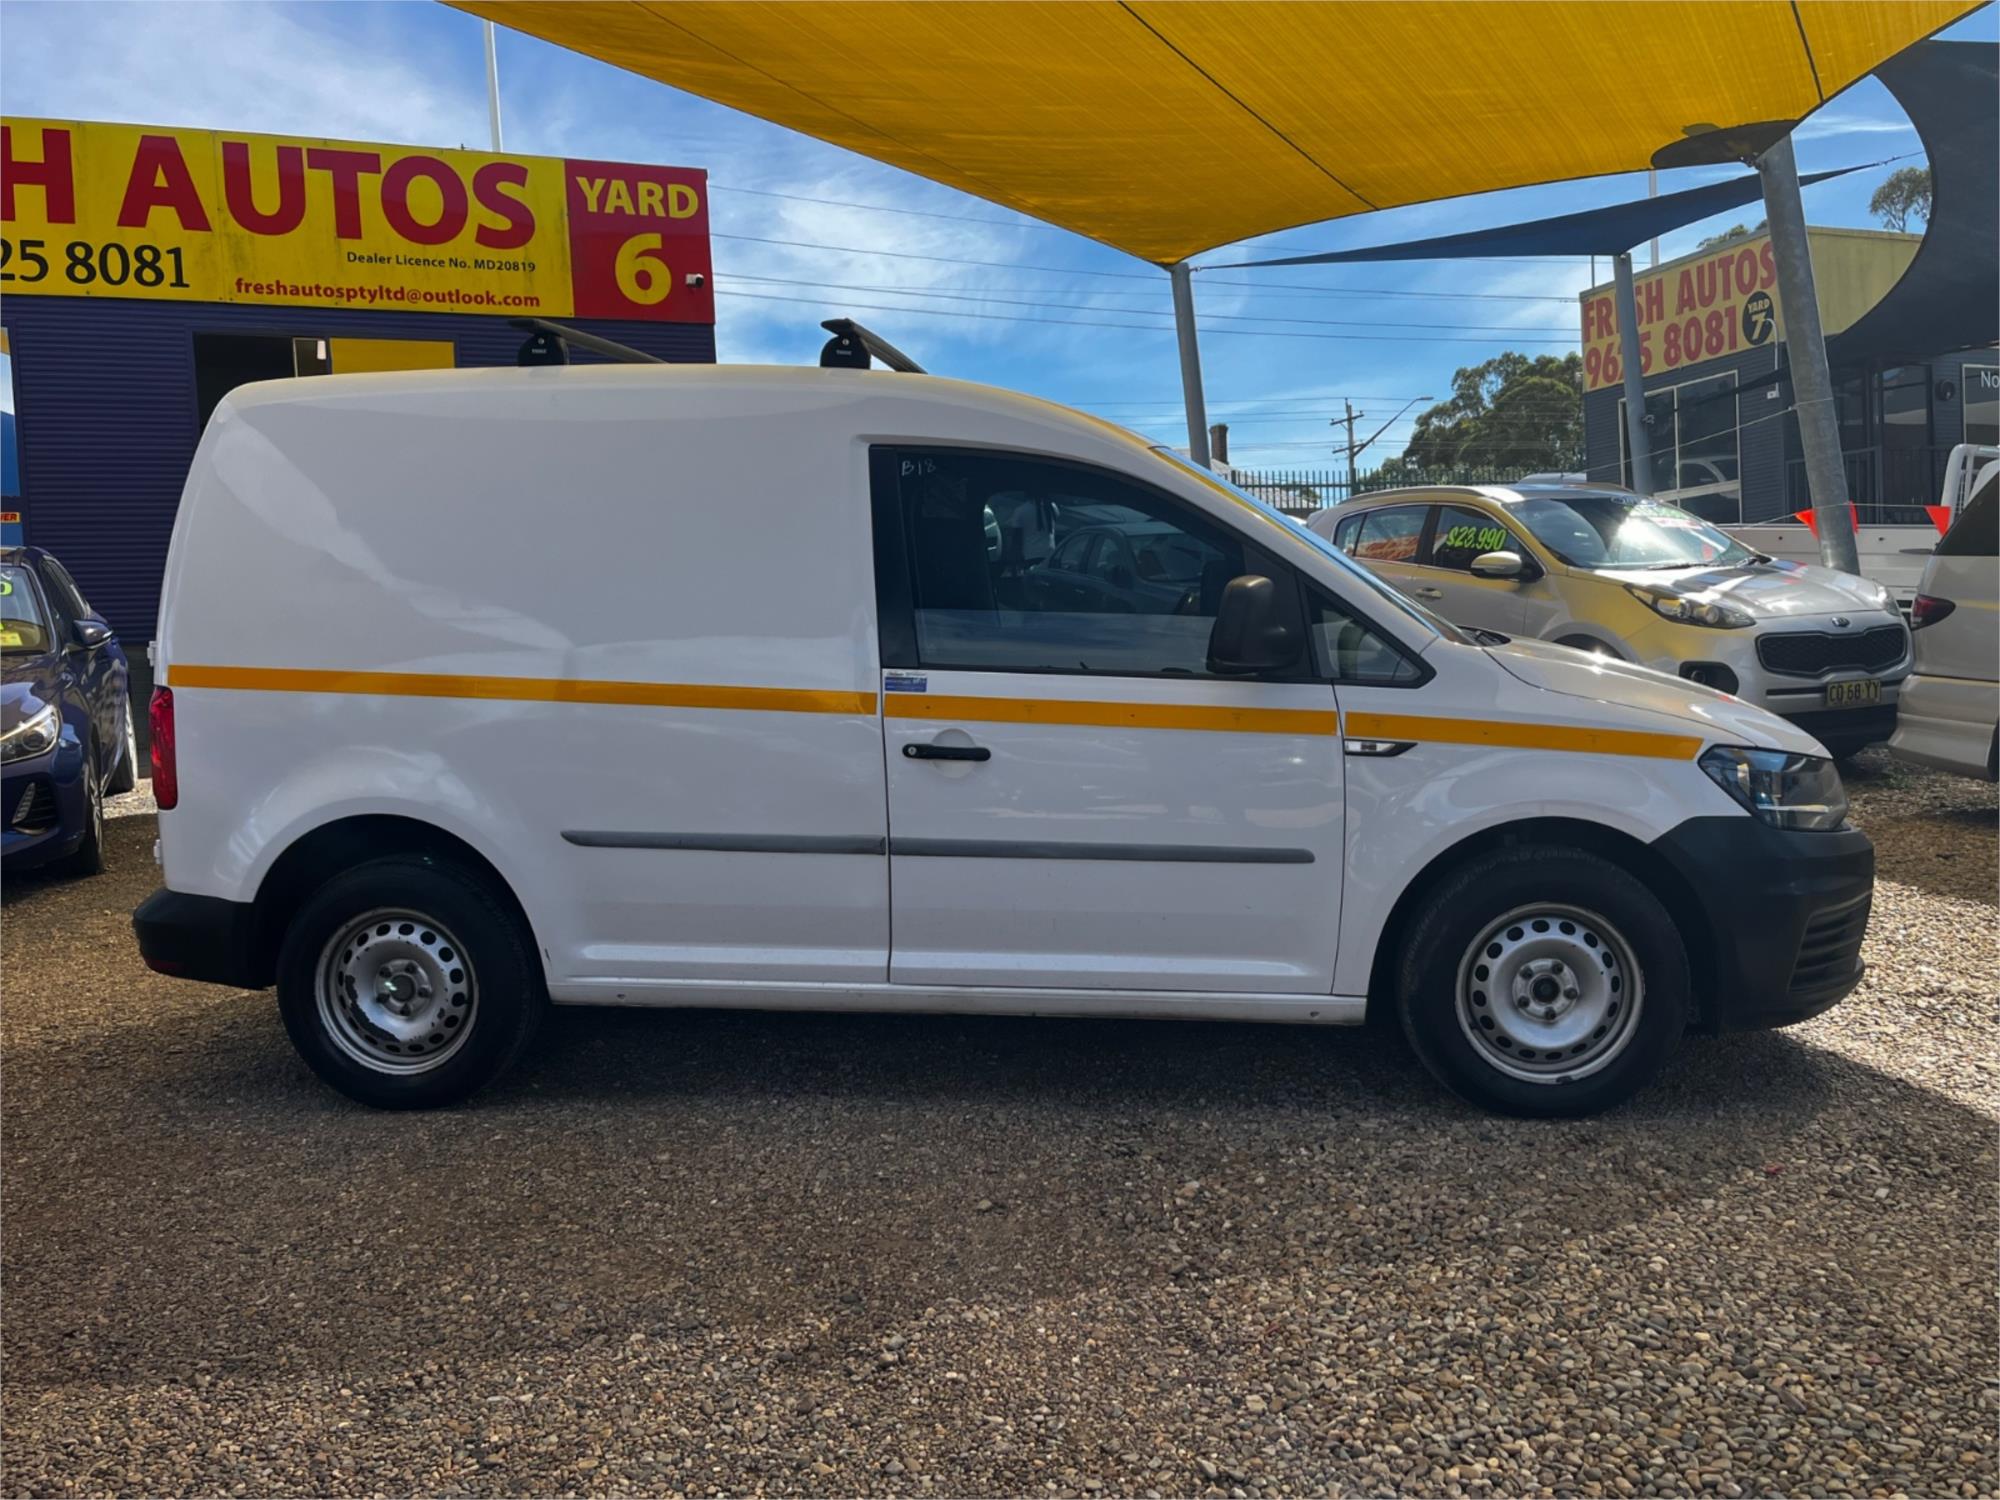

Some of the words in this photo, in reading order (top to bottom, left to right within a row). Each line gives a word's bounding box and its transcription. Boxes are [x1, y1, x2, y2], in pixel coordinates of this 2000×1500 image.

[117, 134, 536, 250] AUTOS
[575, 176, 698, 219] YARD
[65, 241, 190, 288] 8081
[346, 251, 392, 265] Dealer
[396, 254, 445, 268] Licence
[448, 257, 471, 269] No.
[474, 259, 536, 273] MD20819
[614, 233, 672, 305] 6
[1676, 240, 1778, 316] AUTOS
[235, 277, 541, 308] freshautosptyltd@outlook.com
[1747, 298, 1770, 315] YARD
[1585, 330, 1653, 388] 965
[1663, 305, 1738, 367] 8081
[1751, 312, 1767, 341] 7
